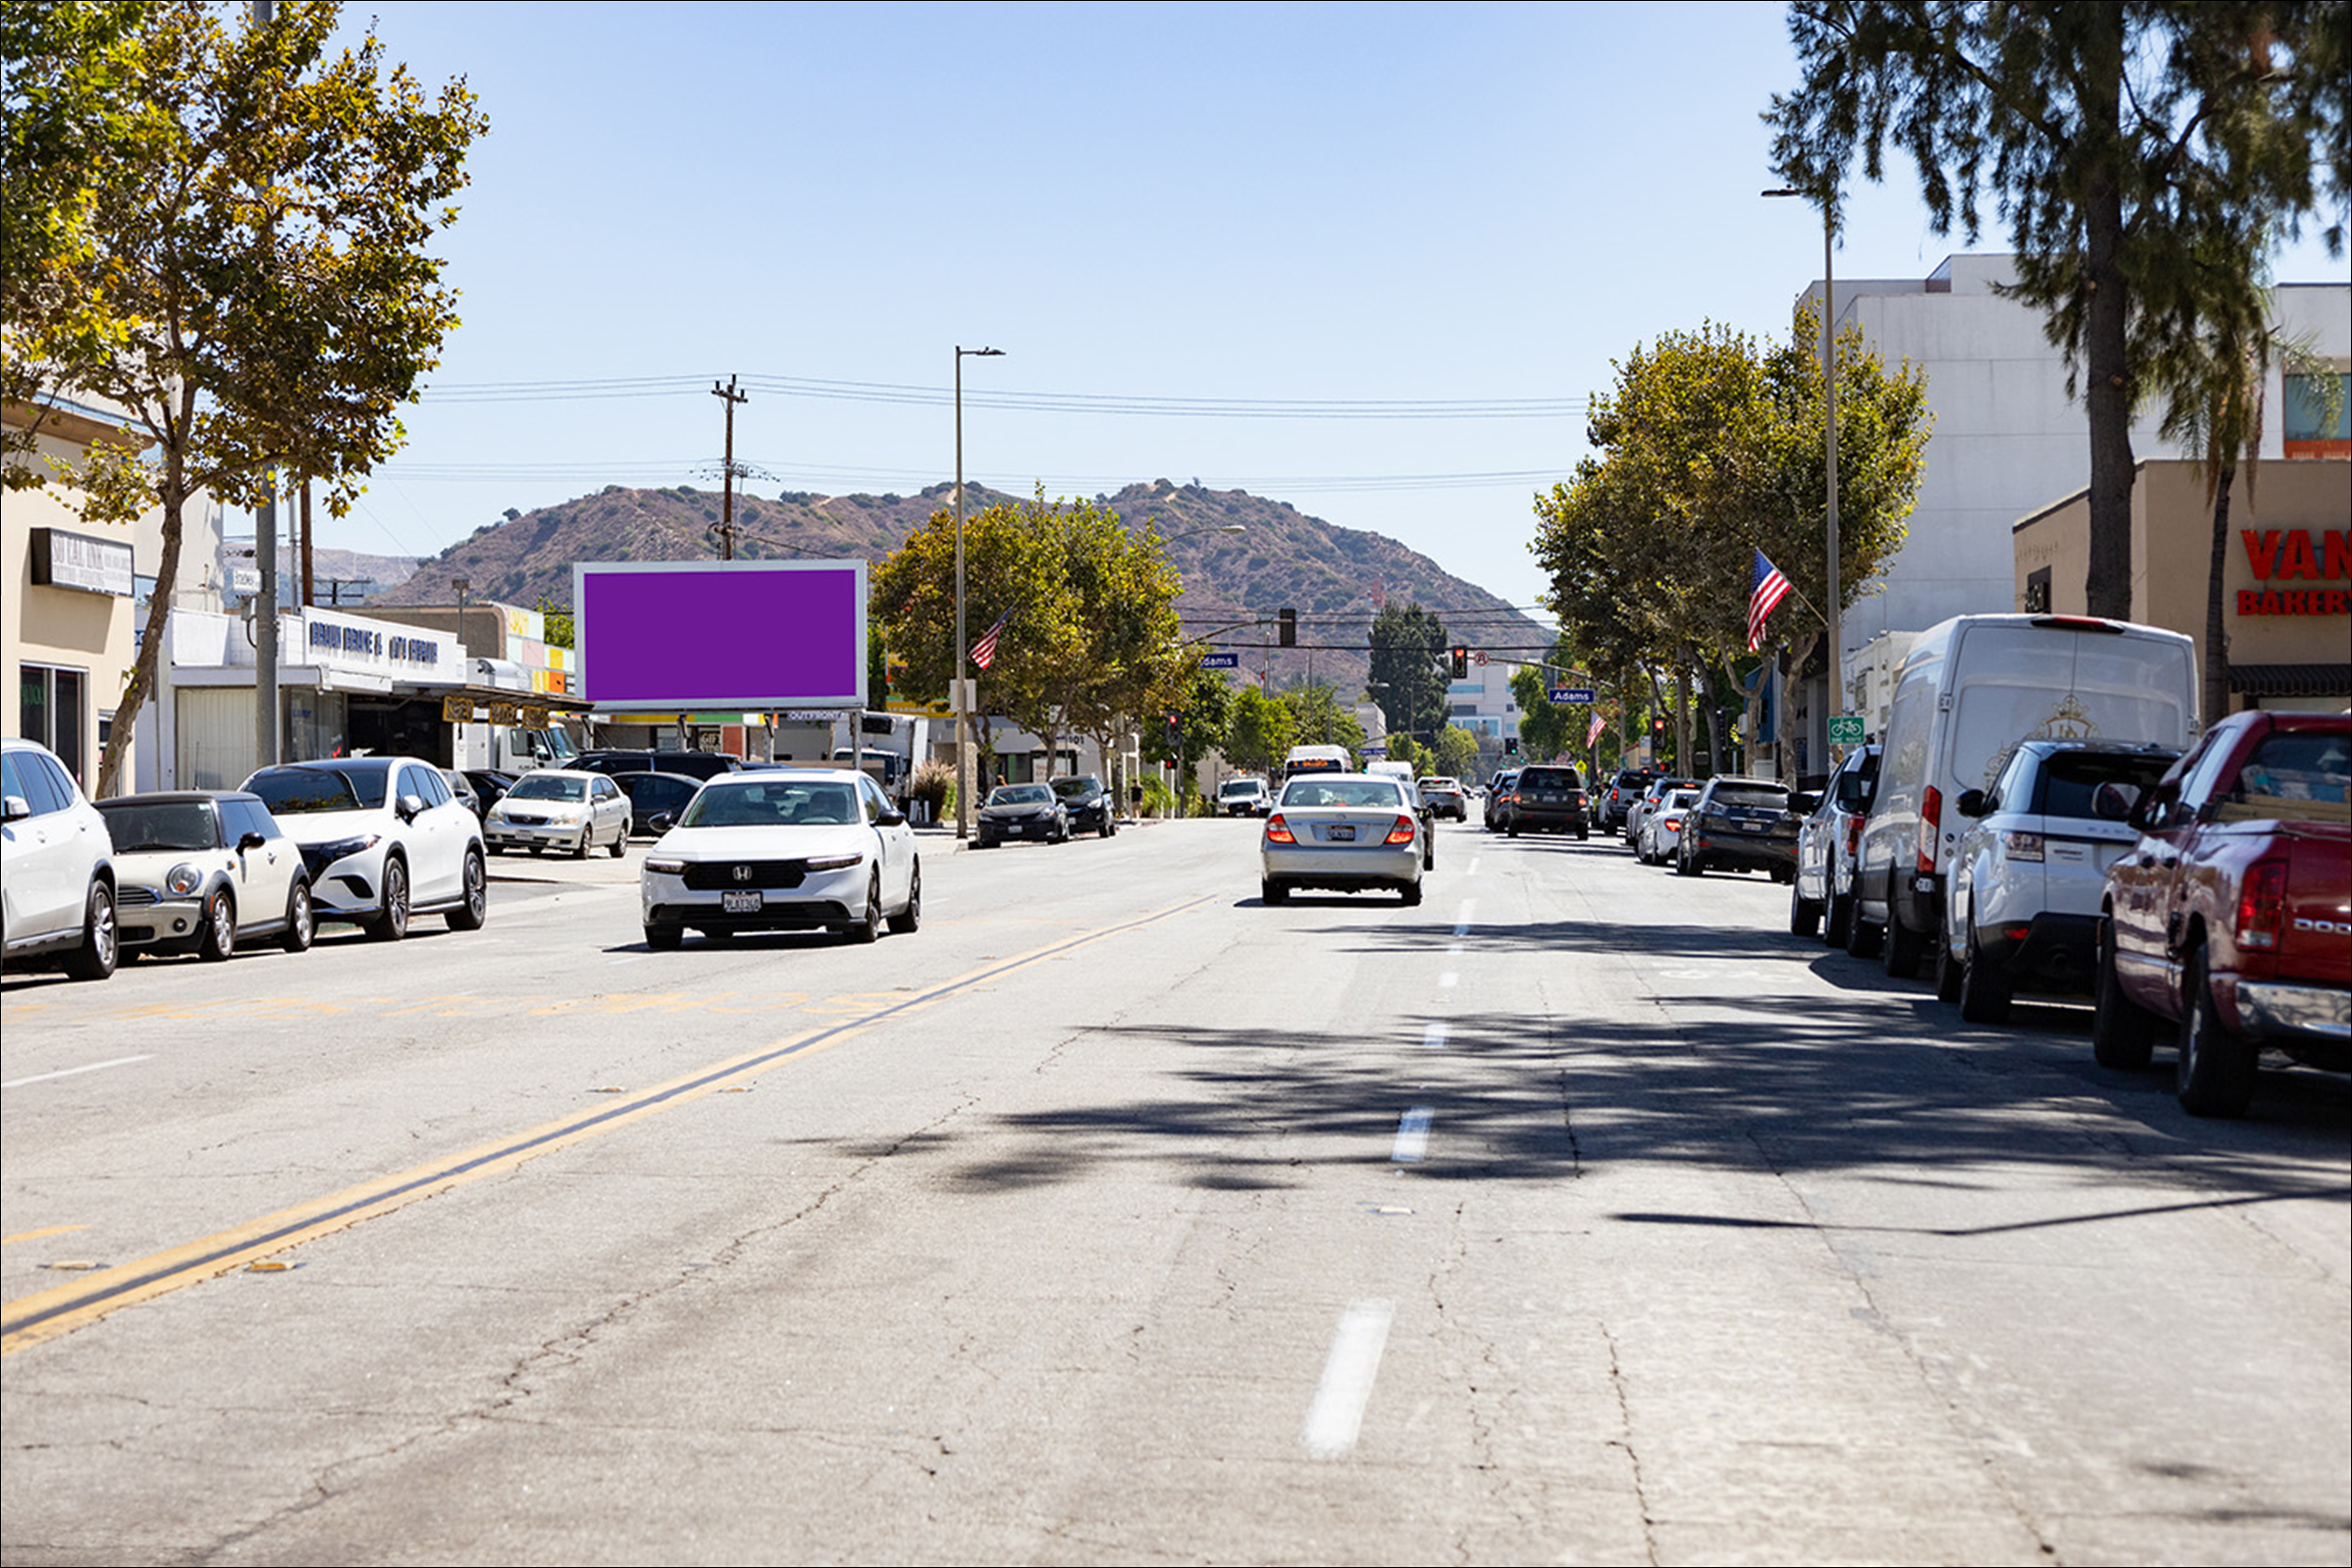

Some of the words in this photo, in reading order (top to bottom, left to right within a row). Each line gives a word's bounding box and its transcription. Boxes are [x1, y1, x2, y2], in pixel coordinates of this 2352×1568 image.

[343, 627, 372, 654] BRAKE
[1202, 656, 1233, 666] dams
[1553, 691, 1590, 701] Adams
[790, 710, 841, 720] OUTFRONT
